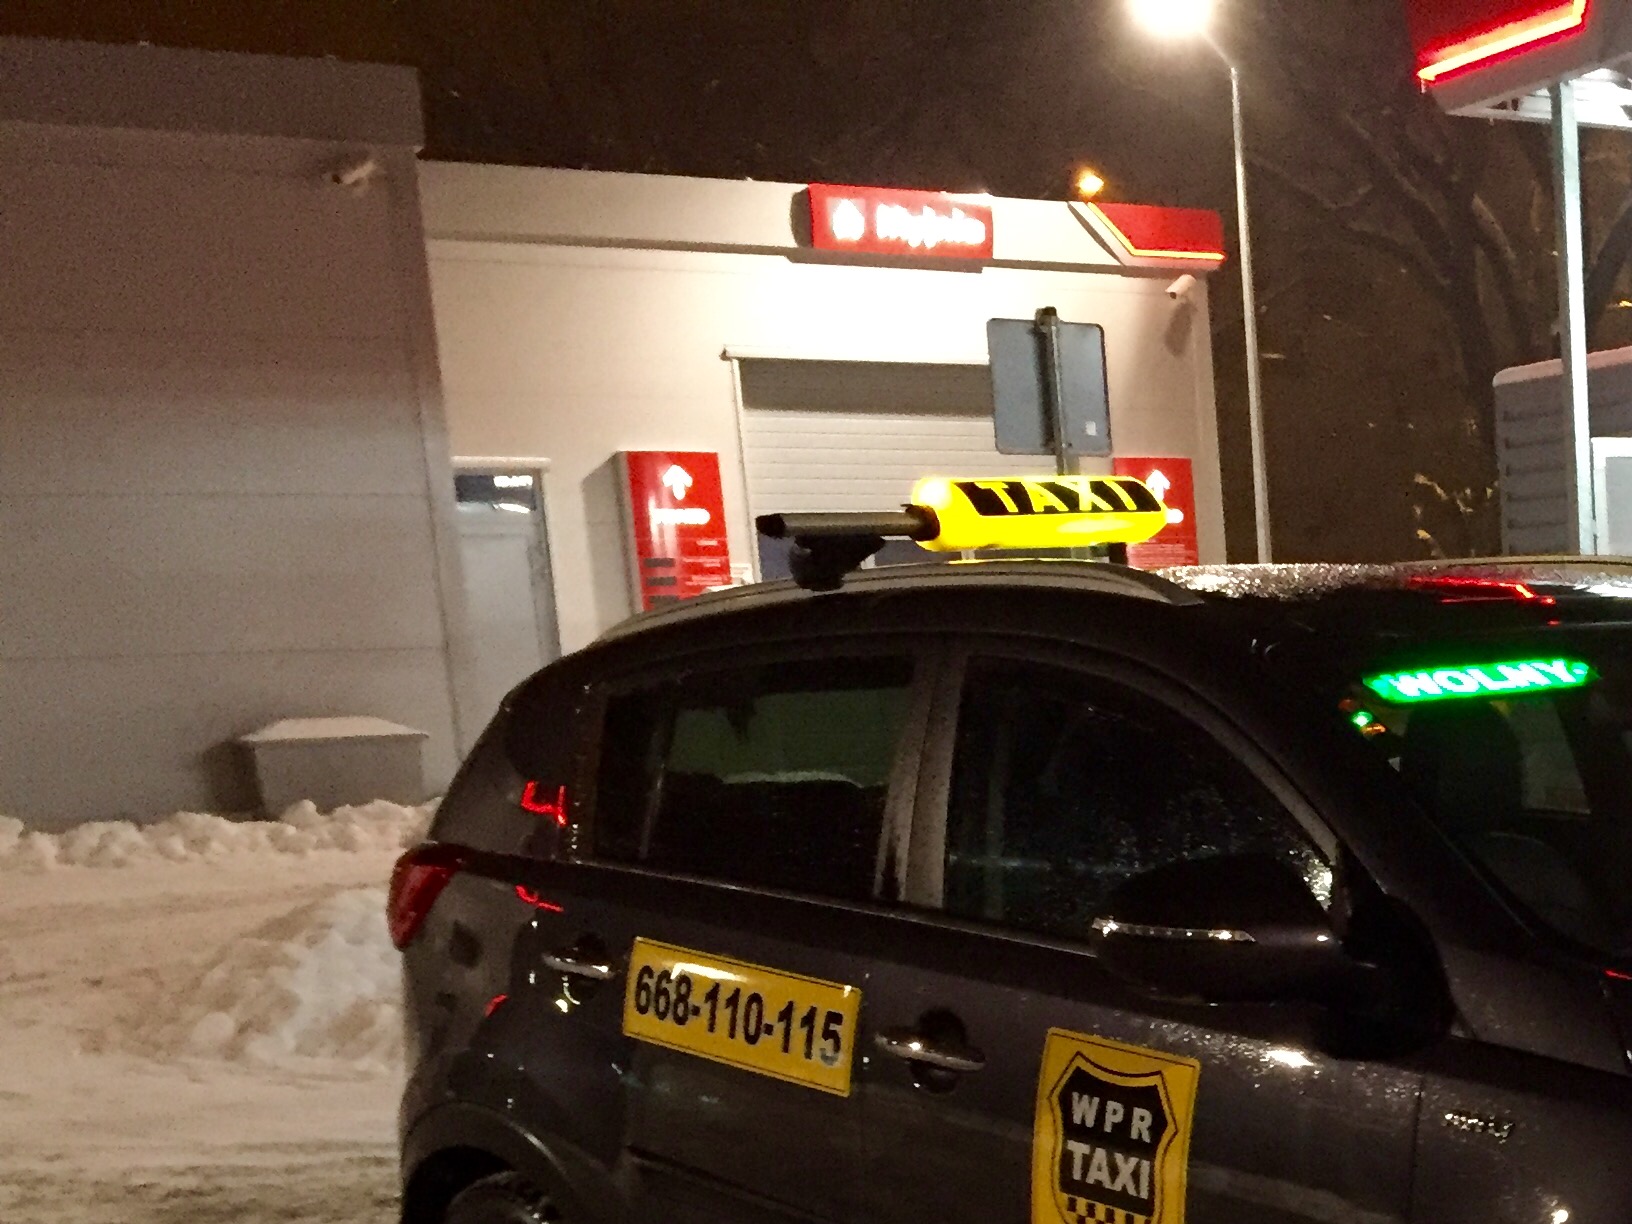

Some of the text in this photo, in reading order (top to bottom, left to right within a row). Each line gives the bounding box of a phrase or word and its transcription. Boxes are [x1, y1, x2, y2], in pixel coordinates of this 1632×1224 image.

[973, 480, 1137, 513] TAXI
[1389, 658, 1577, 697] WOLNY
[634, 964, 845, 1067] 668-110-115
[1066, 1139, 1151, 1200] TAXI
